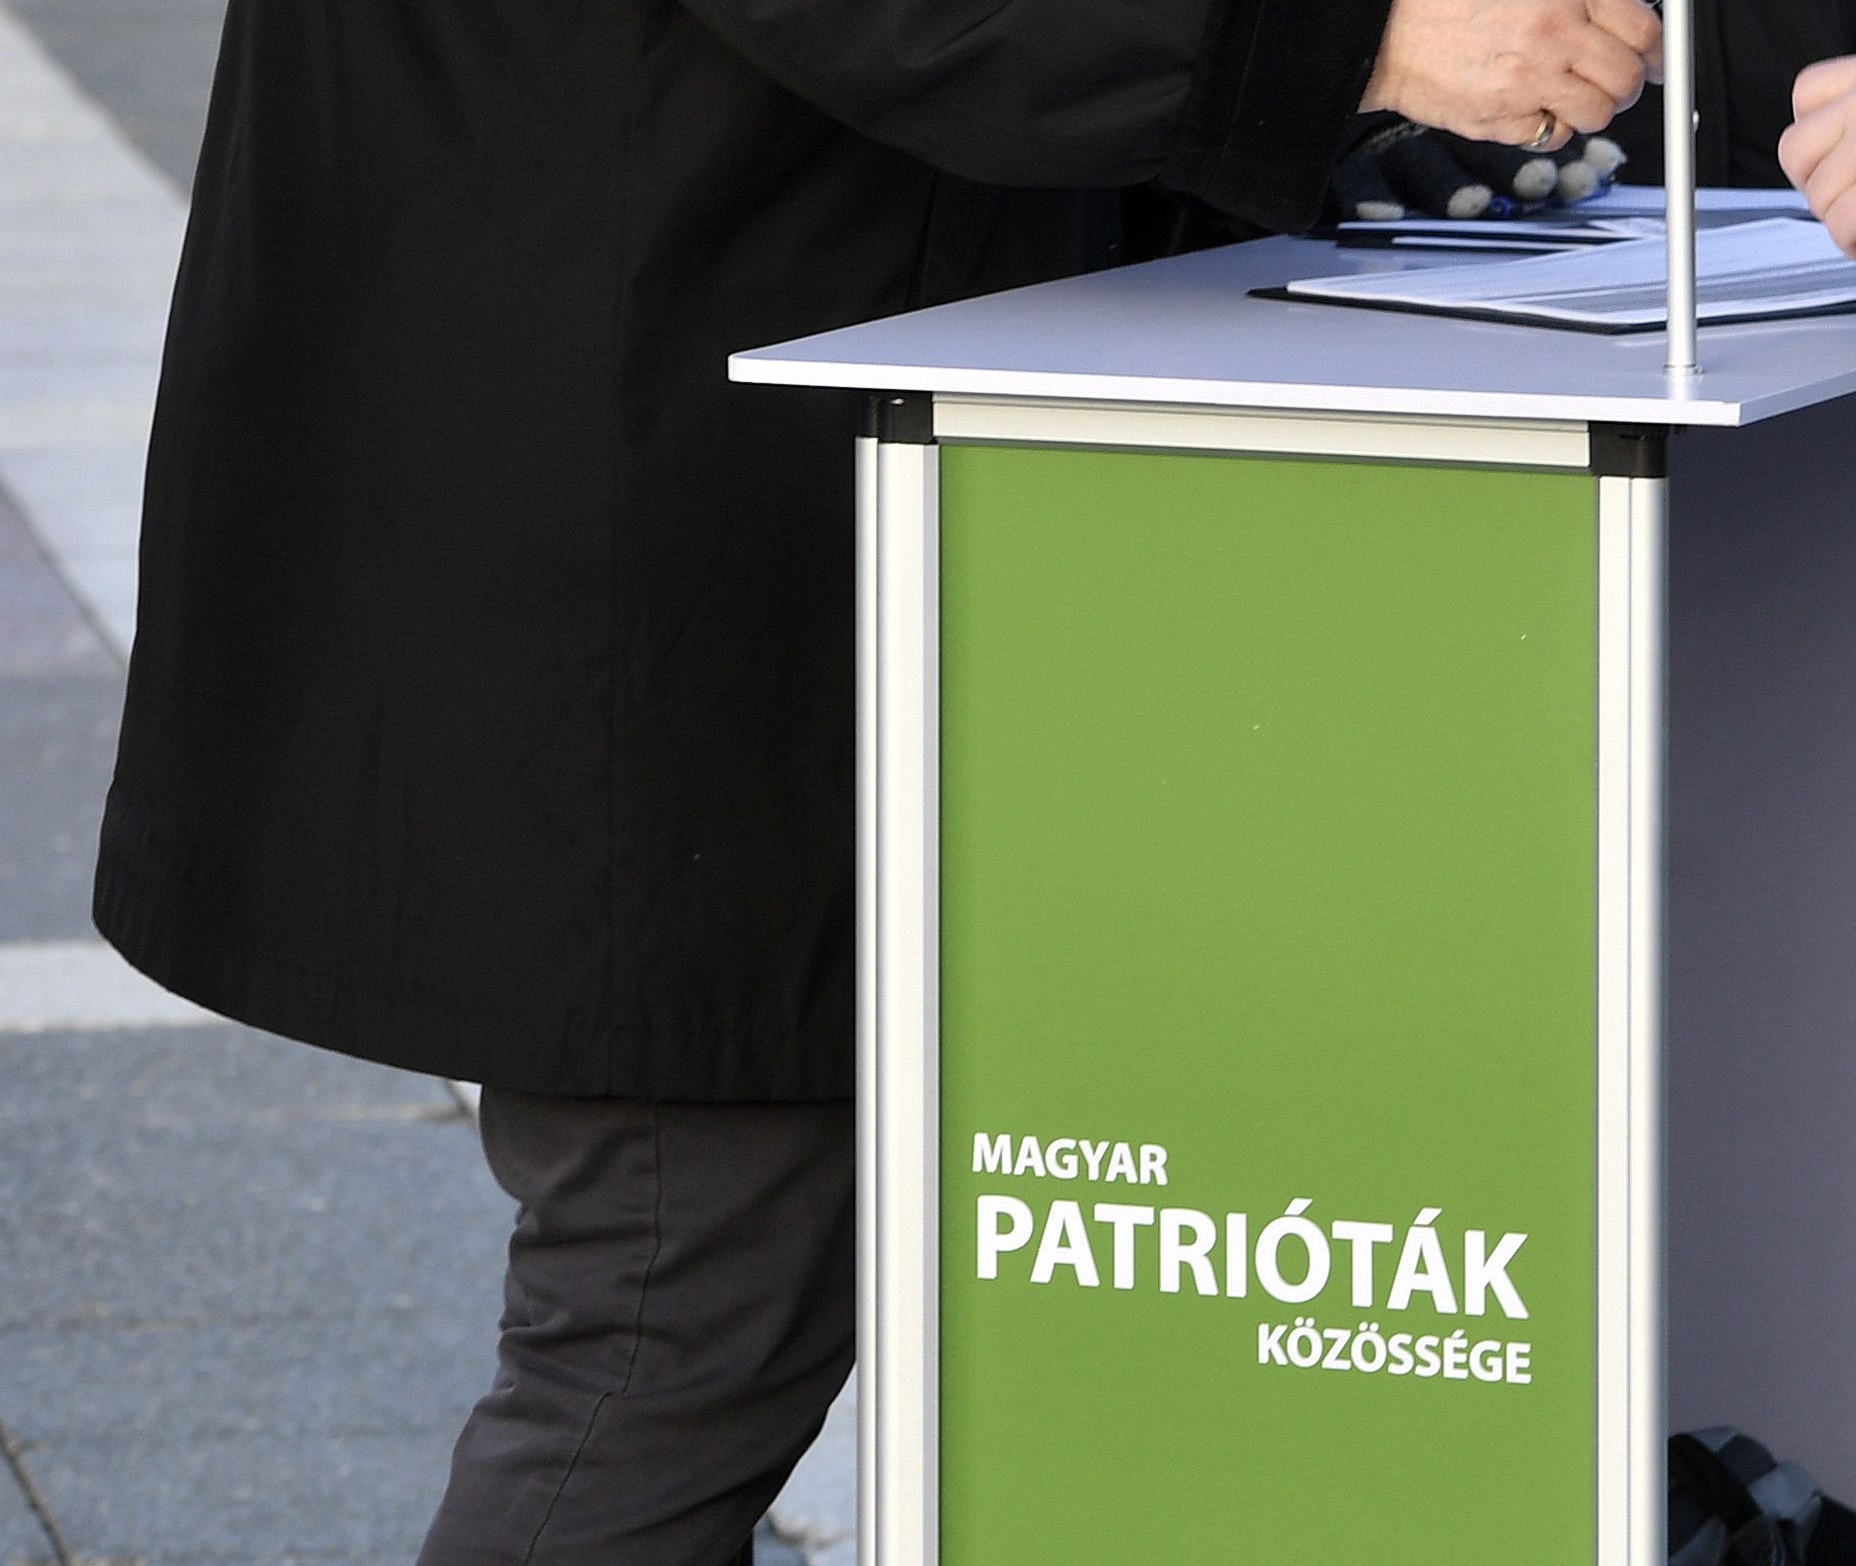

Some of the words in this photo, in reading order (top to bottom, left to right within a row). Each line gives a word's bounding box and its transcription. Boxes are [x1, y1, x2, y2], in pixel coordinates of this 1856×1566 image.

[972, 1132, 1168, 1186] MAGYAR
[976, 1194, 1530, 1320] PATRIÓTÁK
[1258, 1316, 1532, 1385] KÖZÖSSÉGE
